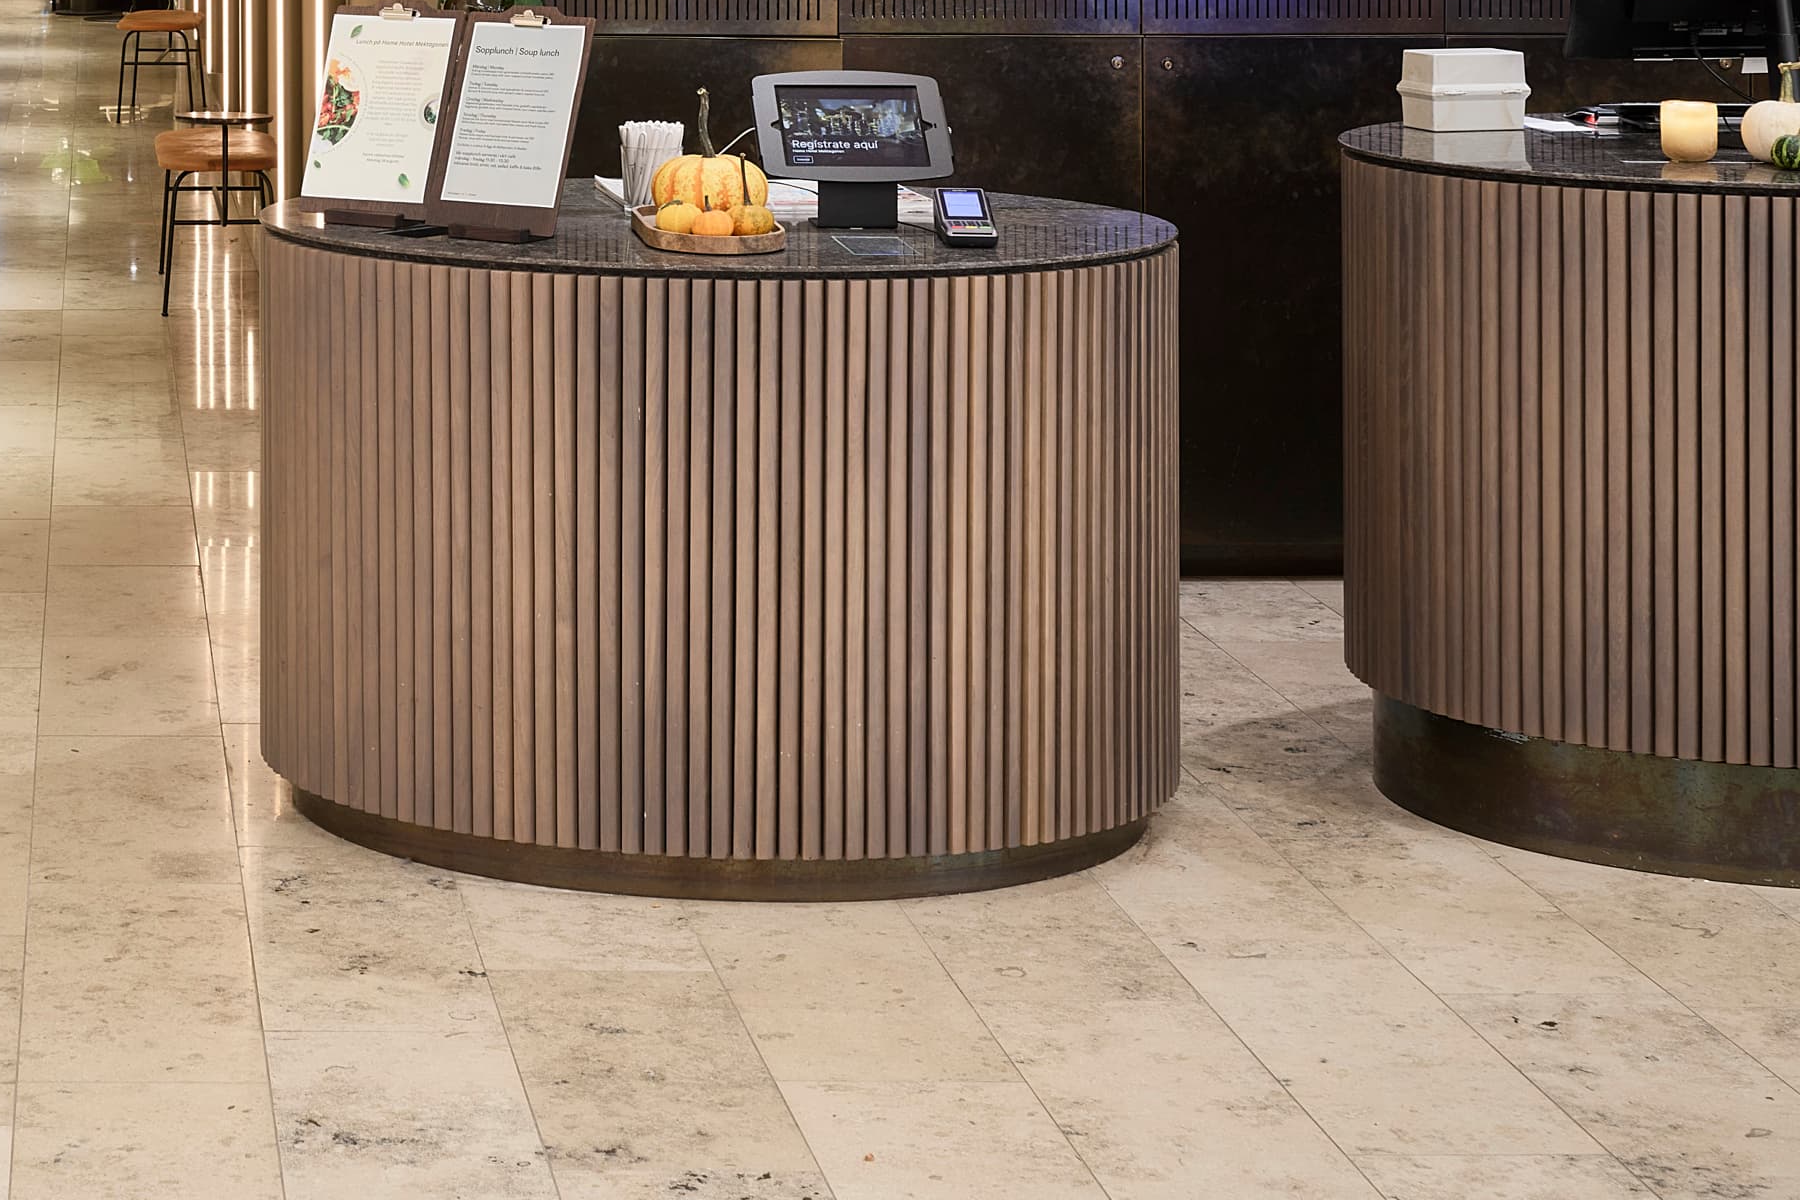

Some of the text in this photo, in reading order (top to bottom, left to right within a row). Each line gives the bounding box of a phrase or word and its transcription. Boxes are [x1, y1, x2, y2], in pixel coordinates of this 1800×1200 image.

[475, 45, 514, 57] Sopplunch
[518, 47, 538, 57] Soup
[539, 48, 560, 57] lunch
